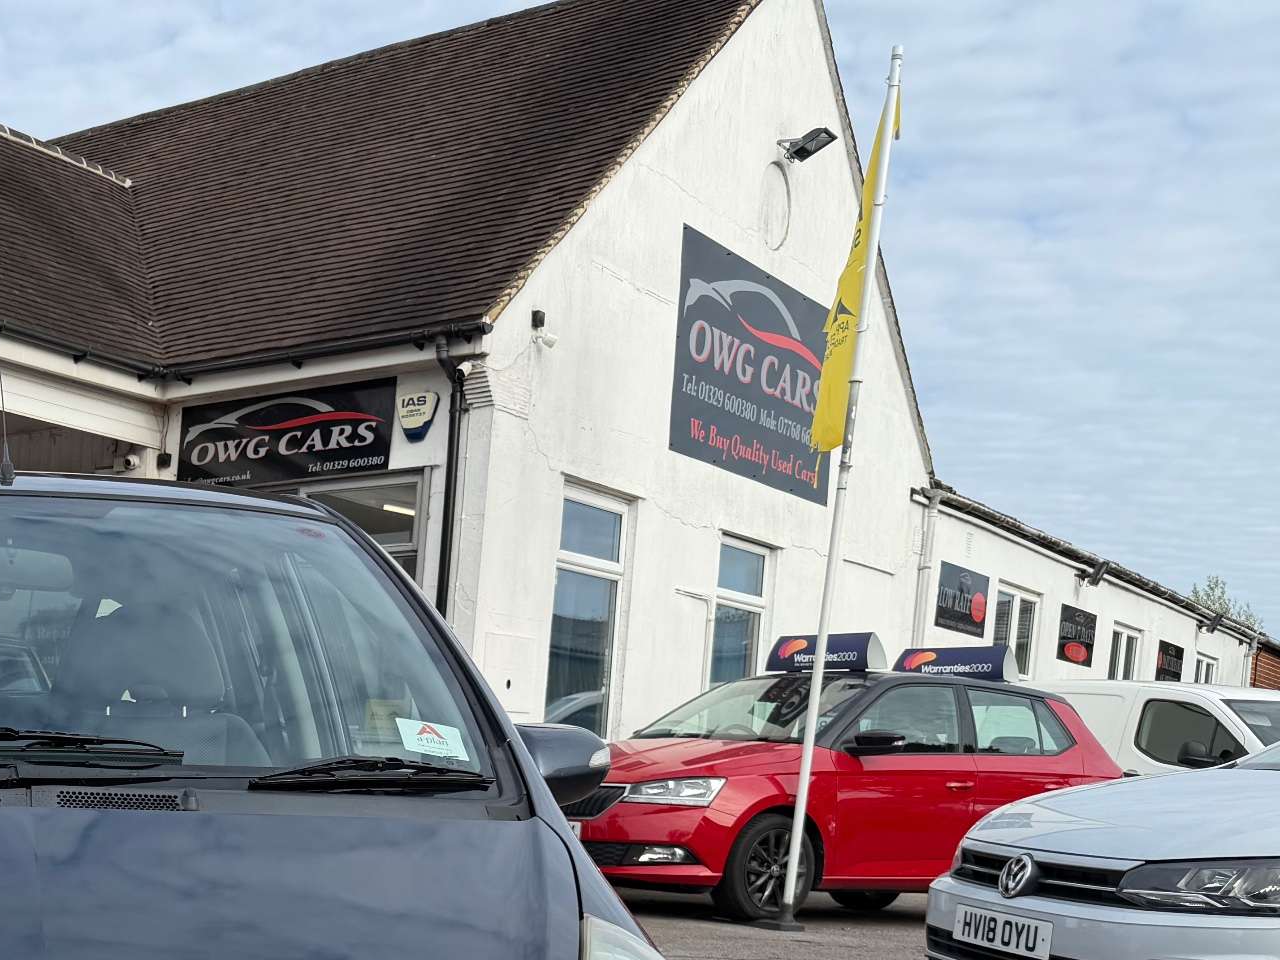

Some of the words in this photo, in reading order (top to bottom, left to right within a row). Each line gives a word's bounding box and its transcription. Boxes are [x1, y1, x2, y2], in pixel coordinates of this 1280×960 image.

[689, 319, 756, 384] OWG
[401, 395, 427, 408] IAS
[682, 373, 698, 396] Tel:
[698, 381, 724, 408] 01329
[724, 393, 757, 422] 600380
[759, 408, 777, 431] Mob:
[777, 417, 801, 441] 07768
[190, 435, 270, 466] OWG
[278, 421, 378, 456] CARS
[307, 462, 322, 473] Tel:
[322, 459, 348, 472] 01329
[348, 455, 385, 469] 600380
[690, 418, 705, 442] We
[708, 425, 730, 461] Buy
[731, 434, 770, 475] Quality
[771, 449, 794, 476] Used
[921, 663, 993, 674] Warranties2000
[961, 910, 998, 943] HV18
[1000, 919, 1039, 953] OYU
